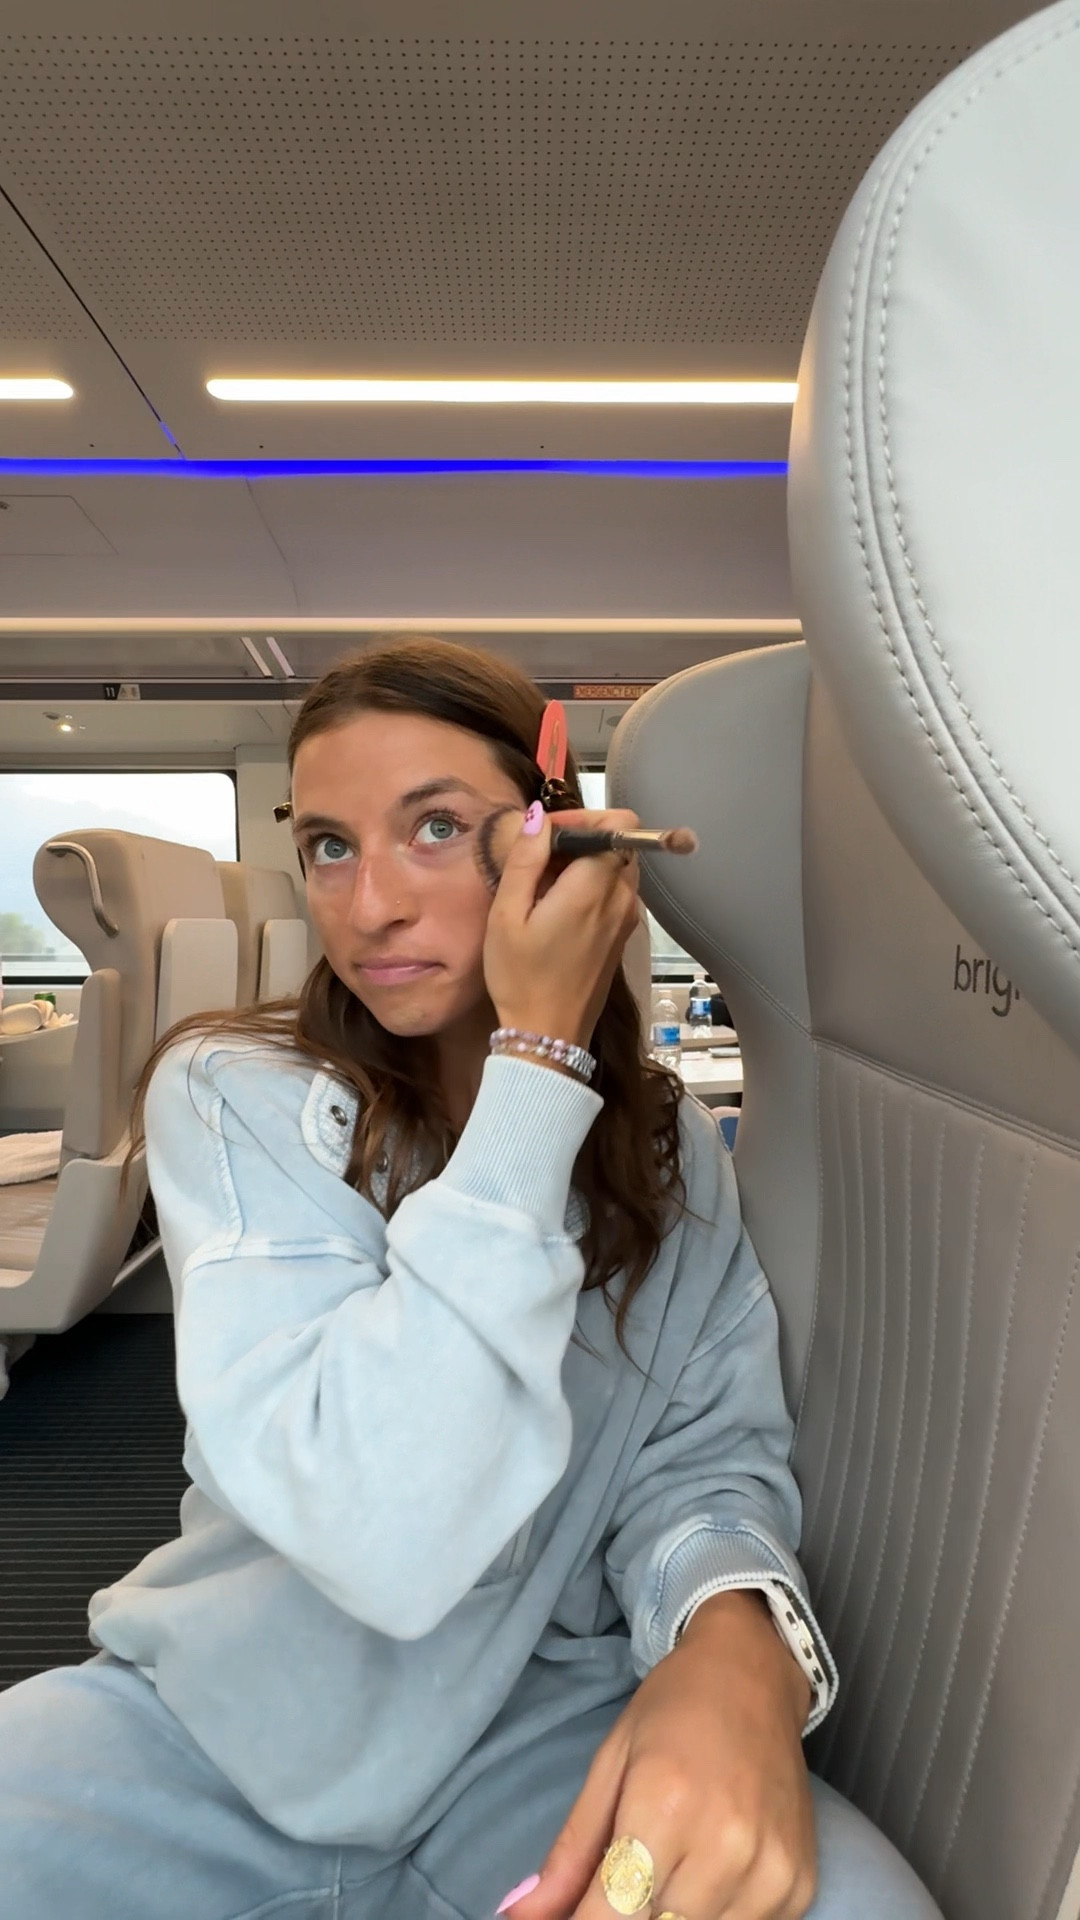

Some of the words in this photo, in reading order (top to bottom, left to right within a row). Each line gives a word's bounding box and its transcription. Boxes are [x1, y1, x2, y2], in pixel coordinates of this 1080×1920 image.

[105, 687, 116, 697] 11
[575, 687, 623, 697] EMERGENCY
[954, 944, 1020, 1017] brig
